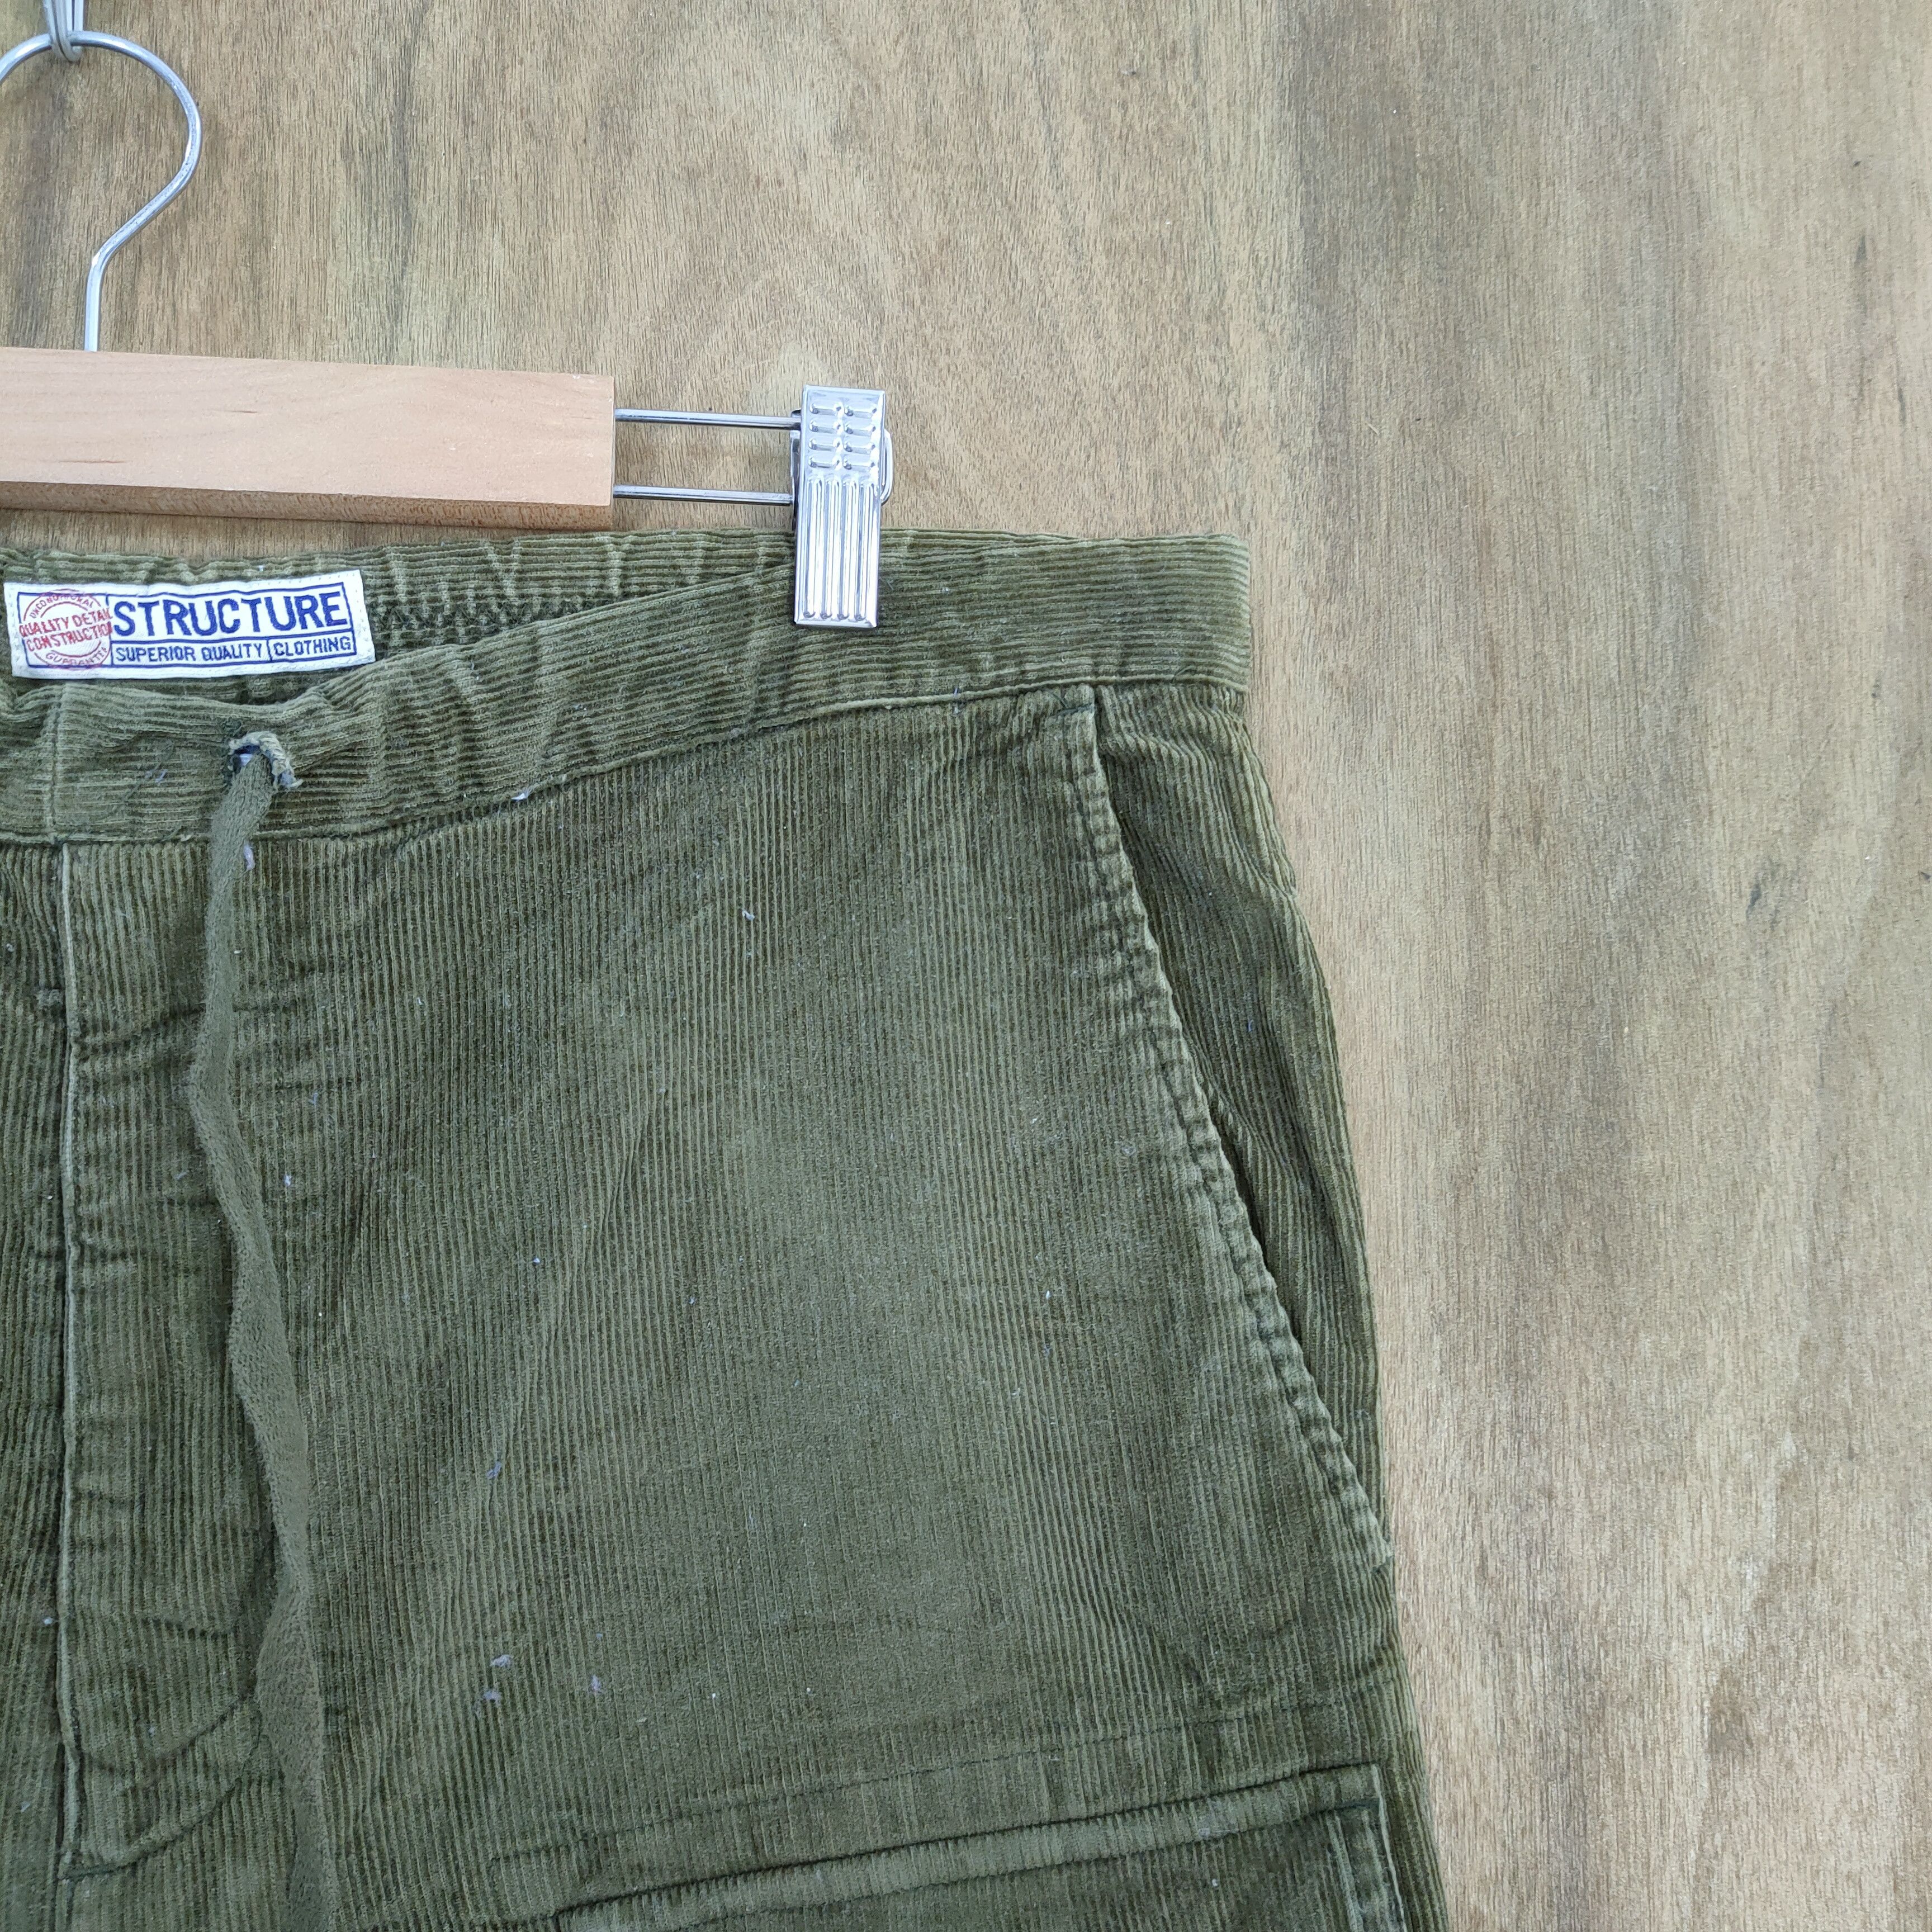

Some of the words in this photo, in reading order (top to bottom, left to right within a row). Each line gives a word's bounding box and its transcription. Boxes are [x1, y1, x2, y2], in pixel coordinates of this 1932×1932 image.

[19, 617, 69, 637] QUALITY
[72, 608, 113, 627] DETAIL
[113, 591, 348, 637] STRUCTURE
[26, 621, 112, 651] CONSTRUCTION
[116, 646, 196, 662] SUPERIOR
[201, 643, 262, 661] QUALITY
[273, 636, 351, 656] CLOTHING
